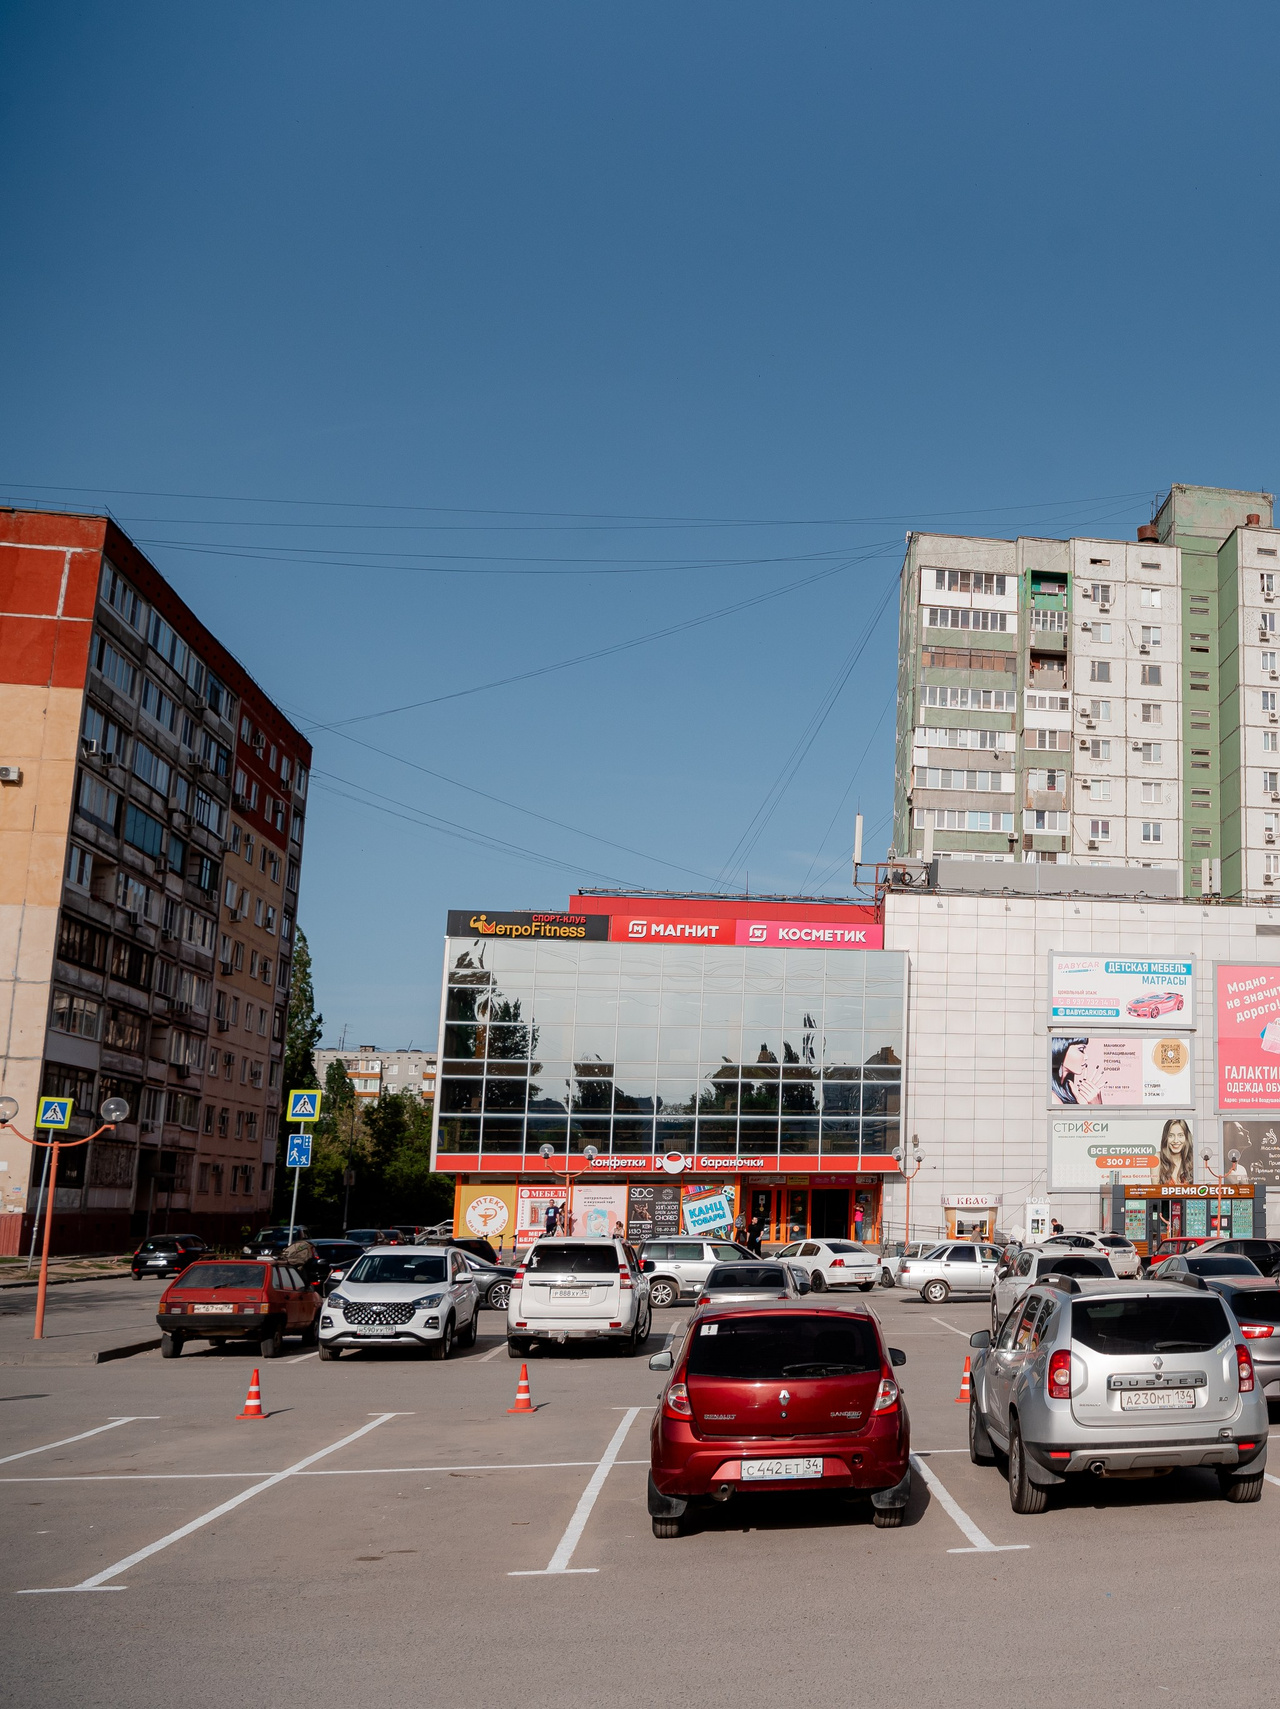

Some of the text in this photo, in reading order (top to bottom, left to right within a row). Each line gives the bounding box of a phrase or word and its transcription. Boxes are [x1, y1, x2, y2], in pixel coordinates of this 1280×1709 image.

[532, 914, 586, 924] СПОРТ-КЛУБ
[651, 924, 719, 938] МАГНИТ
[778, 928, 866, 942] КОСМЕТИК
[1058, 961, 1100, 970] BABYCAR
[1108, 962, 1186, 973] ДЕТСКАЯ МЕБЕЛЬ
[1142, 976, 1187, 986] МАТРАСЫ
[1227, 976, 1267, 994] Модно
[1226, 998, 1240, 1009] не
[1236, 999, 1280, 1023] дорого!
[1227, 1082, 1264, 1093] ОДЕЖДА
[591, 1156, 764, 1170] конфетки бараночки
[631, 1188, 654, 1198] SDC
[1161, 1187, 1197, 1195] ВРЕМЯ
[1209, 1187, 1235, 1195] ЕСТЬ
[471, 1197, 505, 1211] АПТЕКА
[689, 1201, 724, 1218] КАНЦ
[691, 1212, 726, 1228] ТОВАРЫ
[1113, 1378, 1204, 1387] DUSTER
